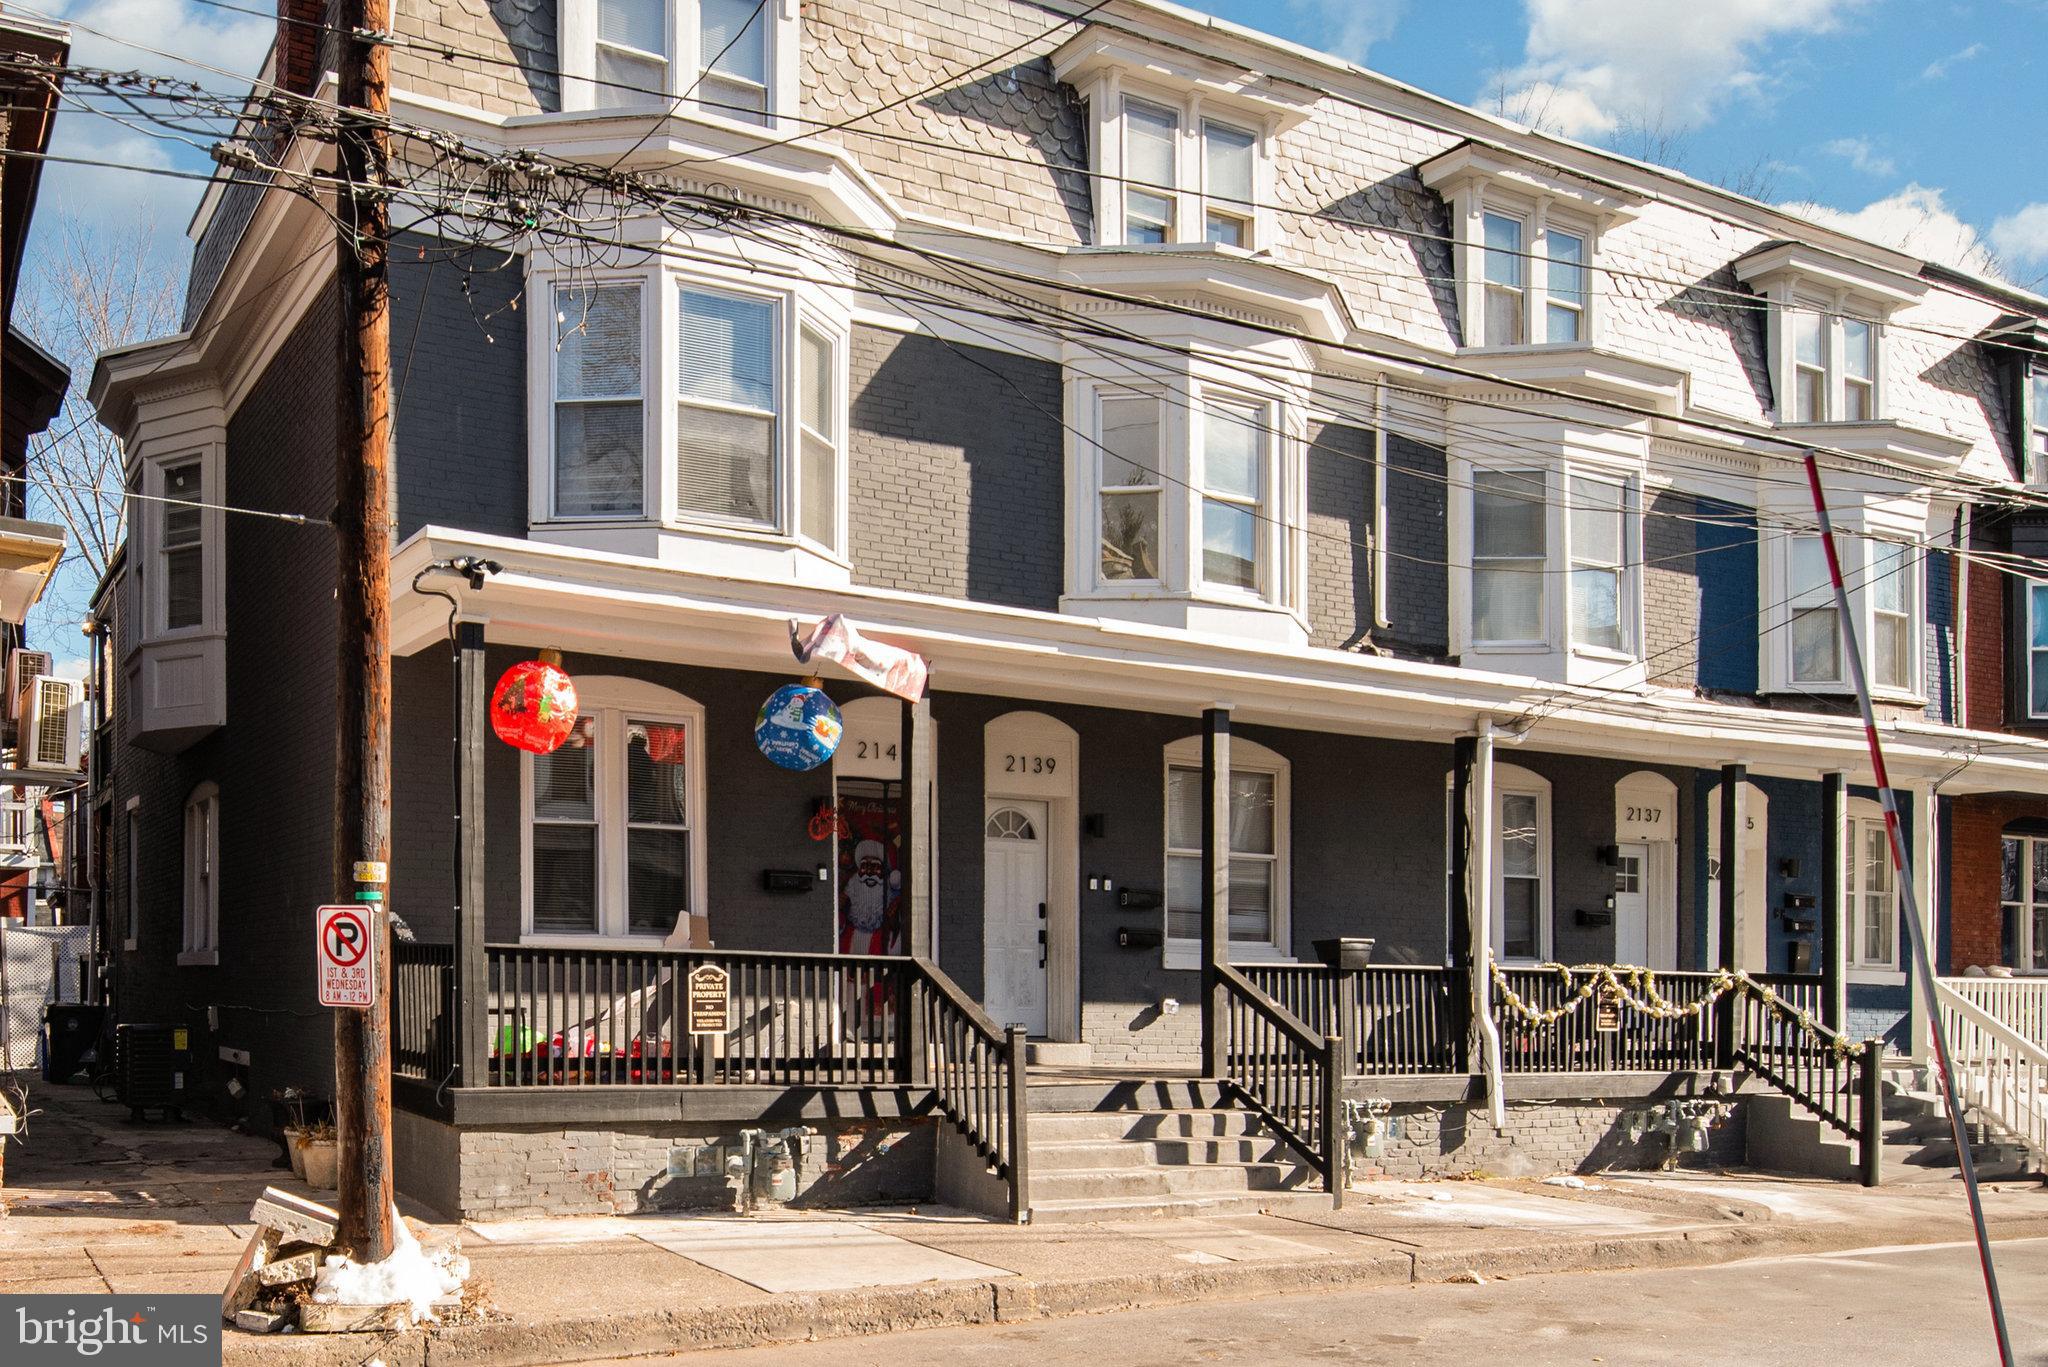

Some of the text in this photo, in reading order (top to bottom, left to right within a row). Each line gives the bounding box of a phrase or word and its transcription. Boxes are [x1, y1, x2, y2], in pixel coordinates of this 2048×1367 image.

[858, 741, 896, 761] 214
[1006, 755, 1056, 774] 2139
[1627, 807, 1661, 823] 2137
[326, 967, 366, 979] 1ST & 3RD
[326, 979, 366, 990] WEDNESDAY
[325, 990, 330, 1001] 8
[333, 991, 341, 1001] AM
[358, 992, 368, 1002] PM
